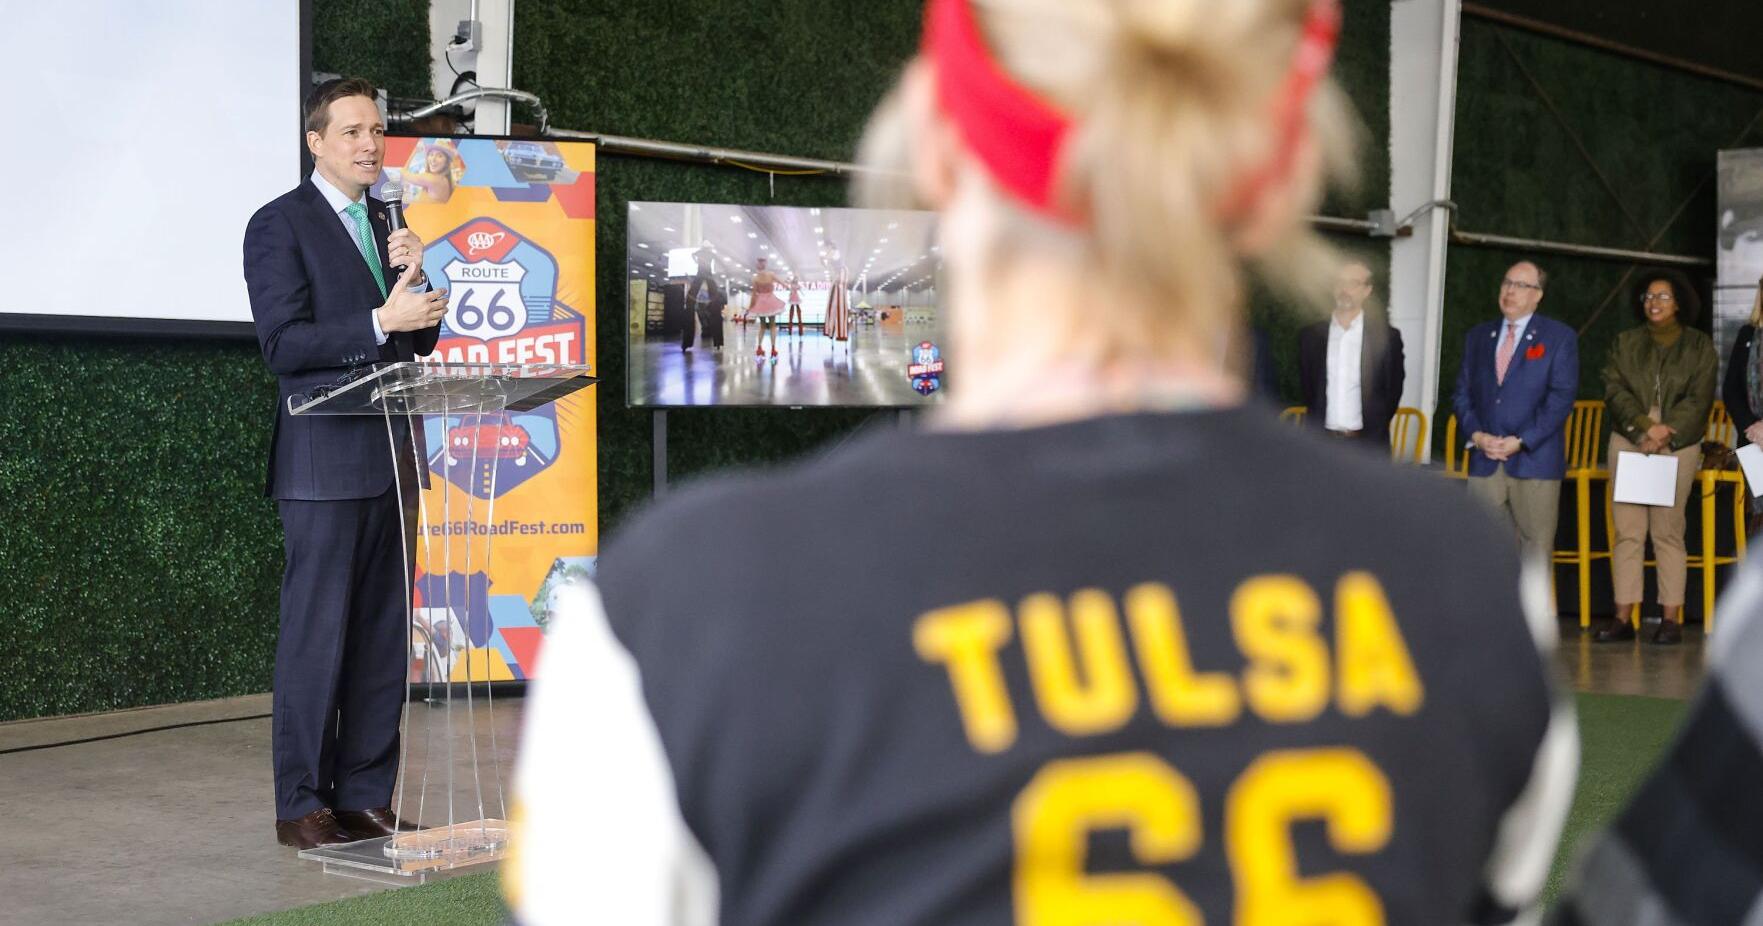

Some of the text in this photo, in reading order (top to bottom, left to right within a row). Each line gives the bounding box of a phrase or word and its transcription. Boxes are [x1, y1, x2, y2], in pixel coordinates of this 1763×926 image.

[469, 232, 494, 249] AAA
[461, 267, 509, 278] ROUTE
[456, 288, 515, 331] 66
[414, 332, 575, 378] OAD FEST
[912, 570, 1425, 754] TULSA
[1011, 746, 1394, 926] 66
